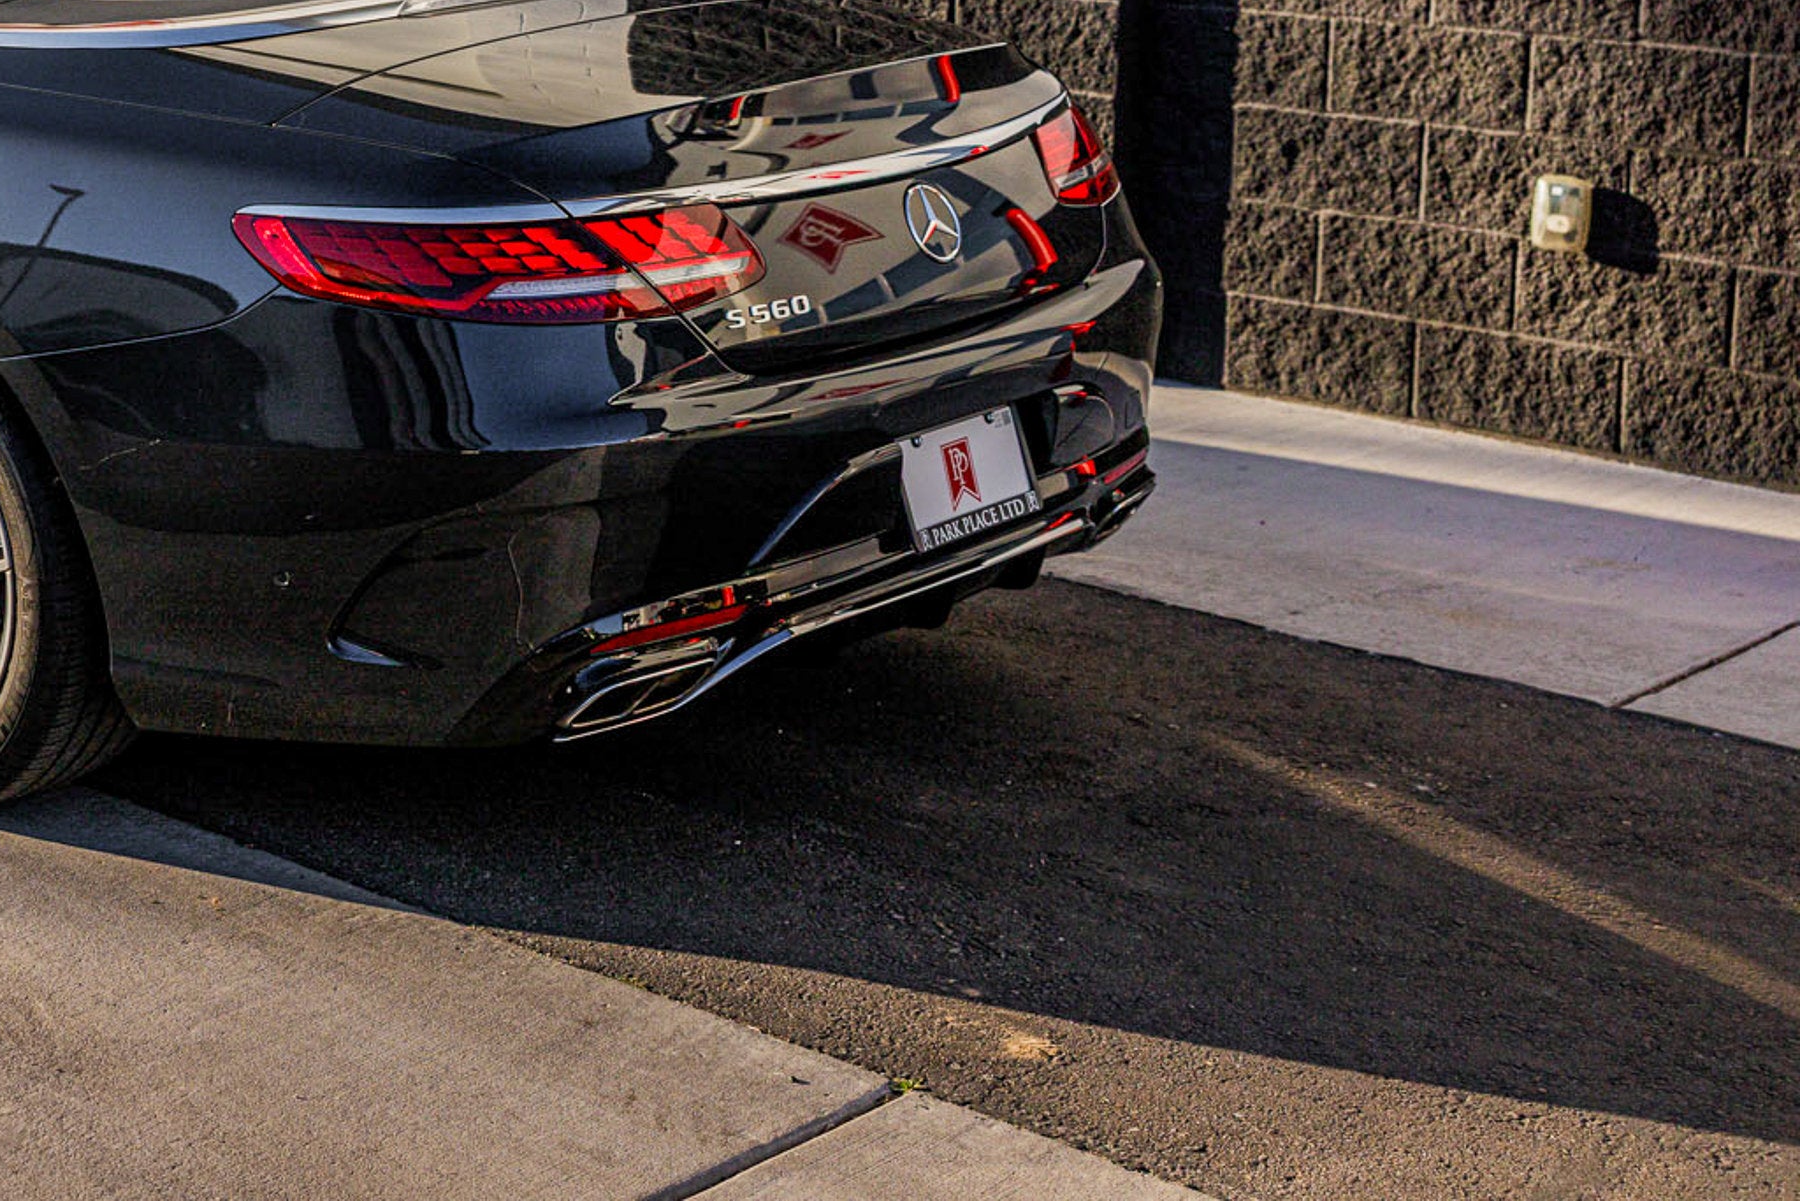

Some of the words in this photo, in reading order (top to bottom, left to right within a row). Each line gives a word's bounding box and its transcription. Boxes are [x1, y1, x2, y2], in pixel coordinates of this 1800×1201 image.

[725, 309, 746, 329] S
[750, 295, 810, 324] 560
[931, 520, 963, 545] PARK
[962, 507, 999, 533] PLACE
[998, 498, 1024, 520] LTD
